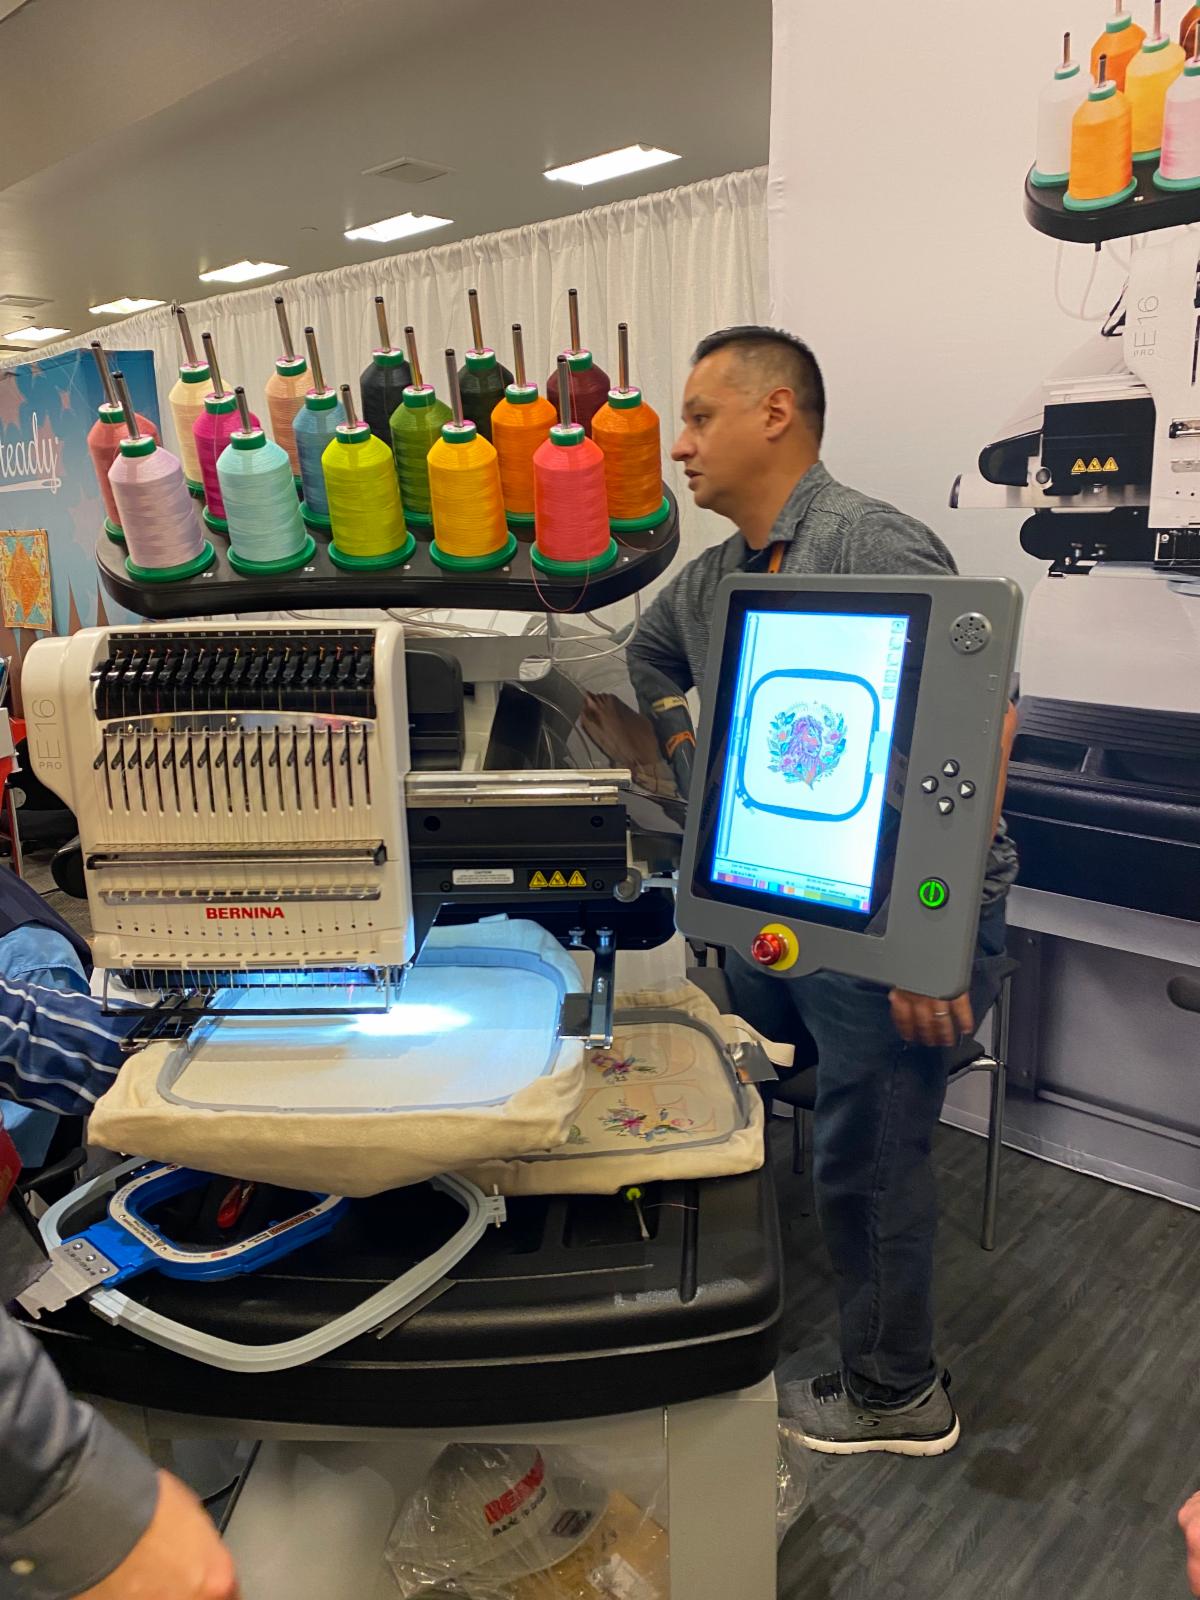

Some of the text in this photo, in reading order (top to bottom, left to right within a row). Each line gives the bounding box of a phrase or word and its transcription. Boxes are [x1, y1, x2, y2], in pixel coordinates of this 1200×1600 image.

[32, 699, 61, 758] E16
[39, 761, 62, 770] PRO
[205, 907, 285, 919] BERNINA
